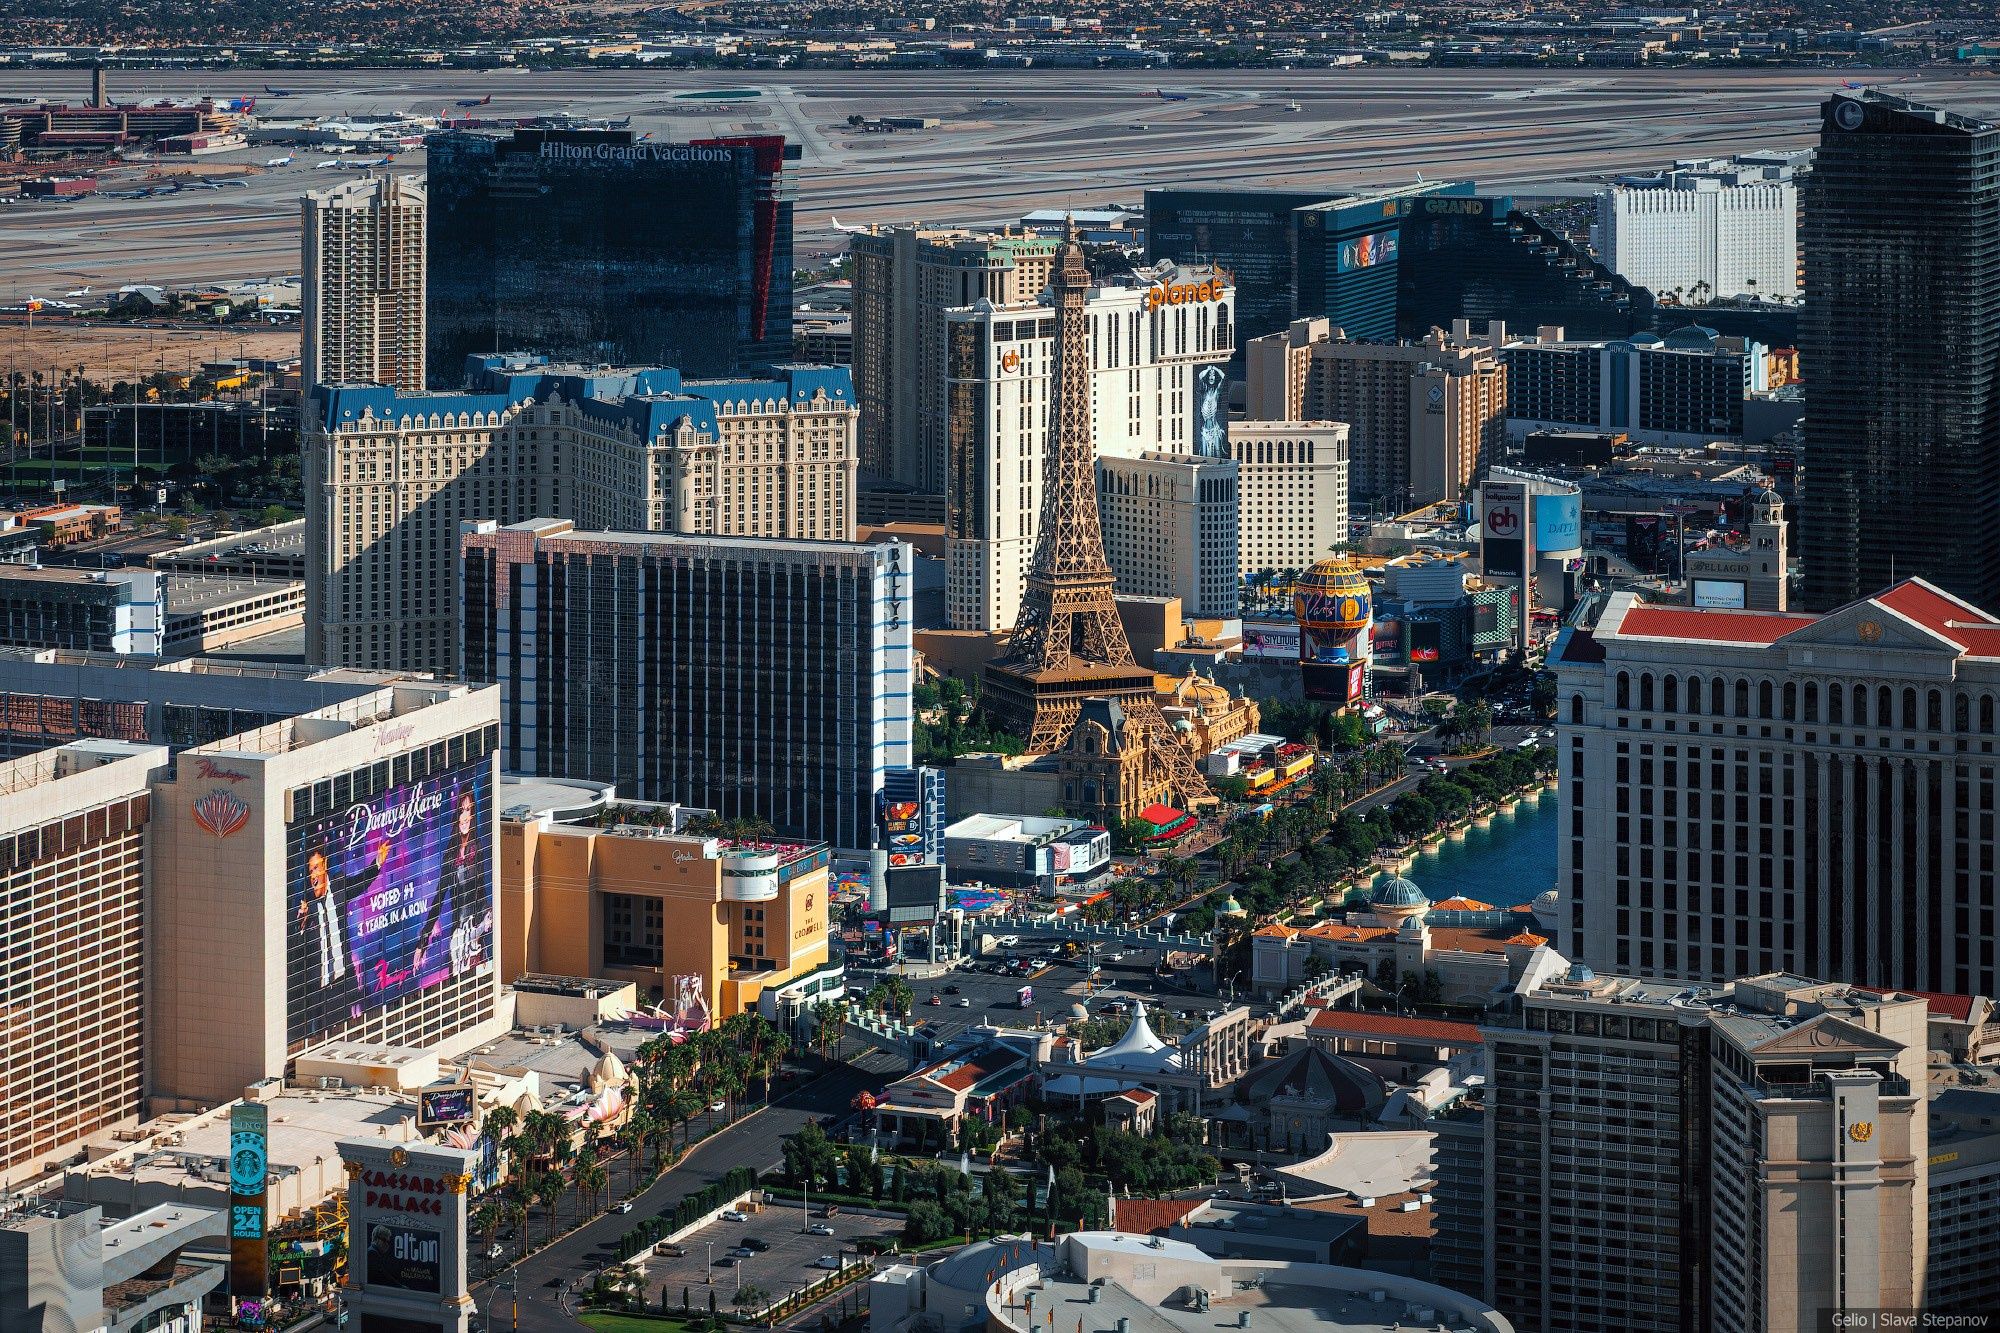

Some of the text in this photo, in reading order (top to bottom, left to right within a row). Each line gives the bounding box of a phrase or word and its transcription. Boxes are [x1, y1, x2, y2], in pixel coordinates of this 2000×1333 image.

[540, 142, 732, 162] Hilton Grand Vacations
[1425, 200, 1484, 215] GRAND
[1149, 277, 1223, 313] planet
[1004, 350, 1020, 368] ph
[1485, 483, 1509, 491] planet
[1485, 492, 1520, 502] hollywood
[1491, 506, 1518, 532] ph
[1488, 569, 1517, 577] Panasonic
[1691, 561, 1749, 573] BELLAGIO
[1305, 590, 1336, 626] Paris
[373, 721, 415, 753] Flamingo
[195, 757, 252, 785] Flamingo
[343, 803, 400, 850] Donny
[404, 781, 442, 828] Marie
[787, 862, 808, 876] GUESS
[403, 882, 415, 902] #1
[357, 899, 428, 937] 3 YEARS IN A ROW
[805, 917, 814, 925] THE
[794, 921, 823, 940] CROMWELL
[232, 1121, 261, 1130] LINQ
[362, 1169, 446, 1196] CAESARS
[233, 1206, 261, 1215] OPEN
[366, 1190, 442, 1216] PALACE
[233, 1214, 261, 1231] 24
[233, 1230, 261, 1239] HOURS
[394, 1232, 438, 1263] elton
